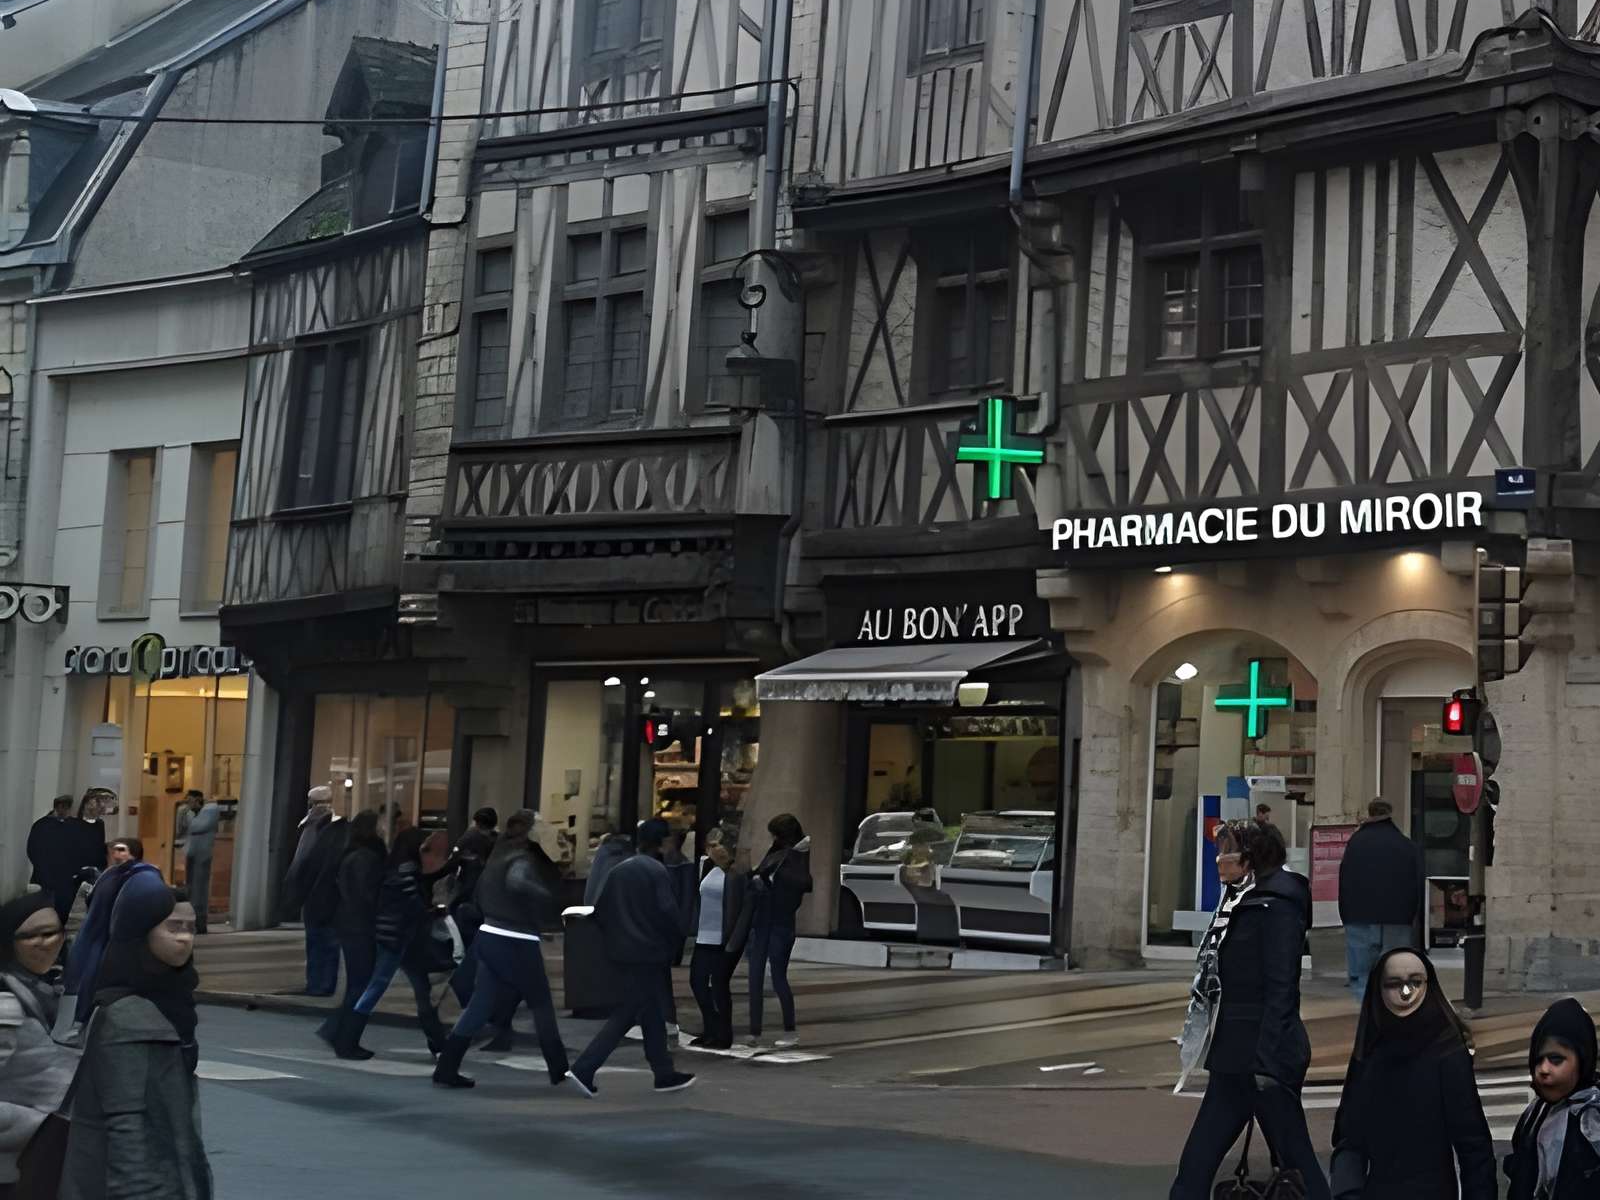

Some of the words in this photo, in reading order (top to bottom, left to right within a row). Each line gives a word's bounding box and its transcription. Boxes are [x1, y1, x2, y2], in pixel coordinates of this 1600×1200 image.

[1052, 507, 1258, 550] PHARMACIE
[1271, 502, 1326, 539] DU
[1340, 491, 1482, 534] MIROIR
[857, 608, 893, 641] AU
